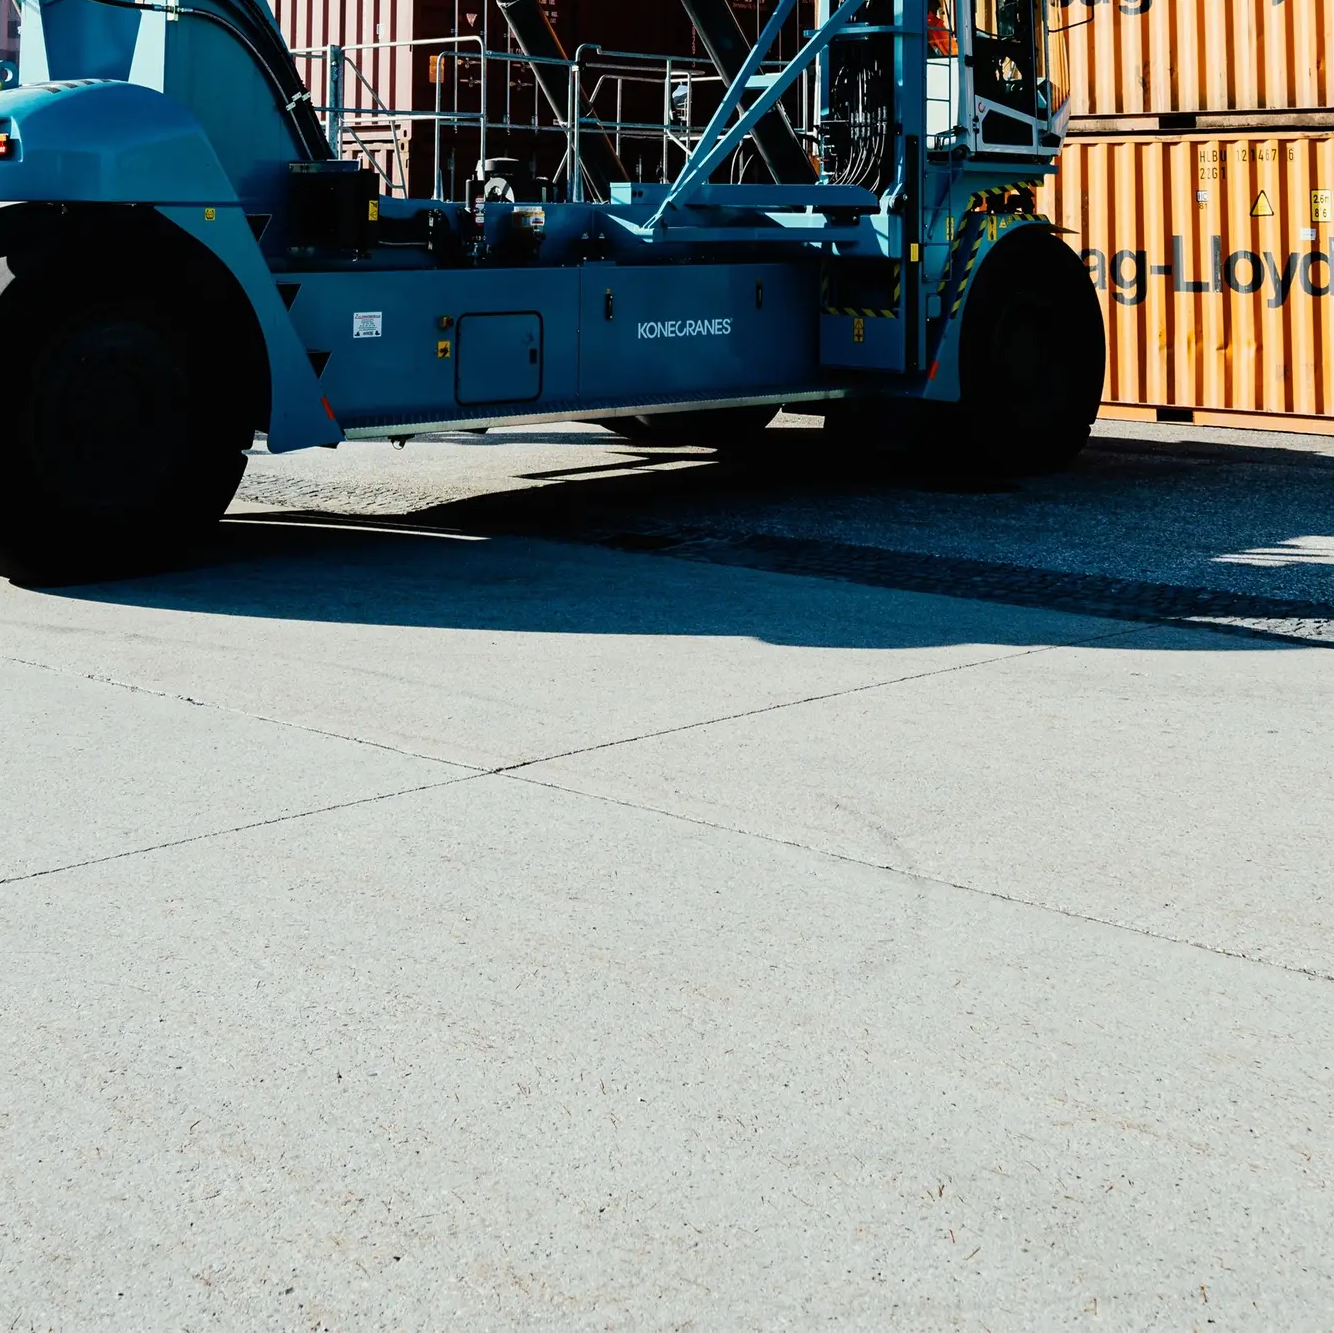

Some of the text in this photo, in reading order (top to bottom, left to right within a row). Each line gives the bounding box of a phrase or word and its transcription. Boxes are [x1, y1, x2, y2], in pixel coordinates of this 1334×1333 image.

[1200, 148, 1294, 163] HLBU 121467 6
[1200, 167, 1227, 179] 22G1
[637, 317, 732, 339] KONECRANES
